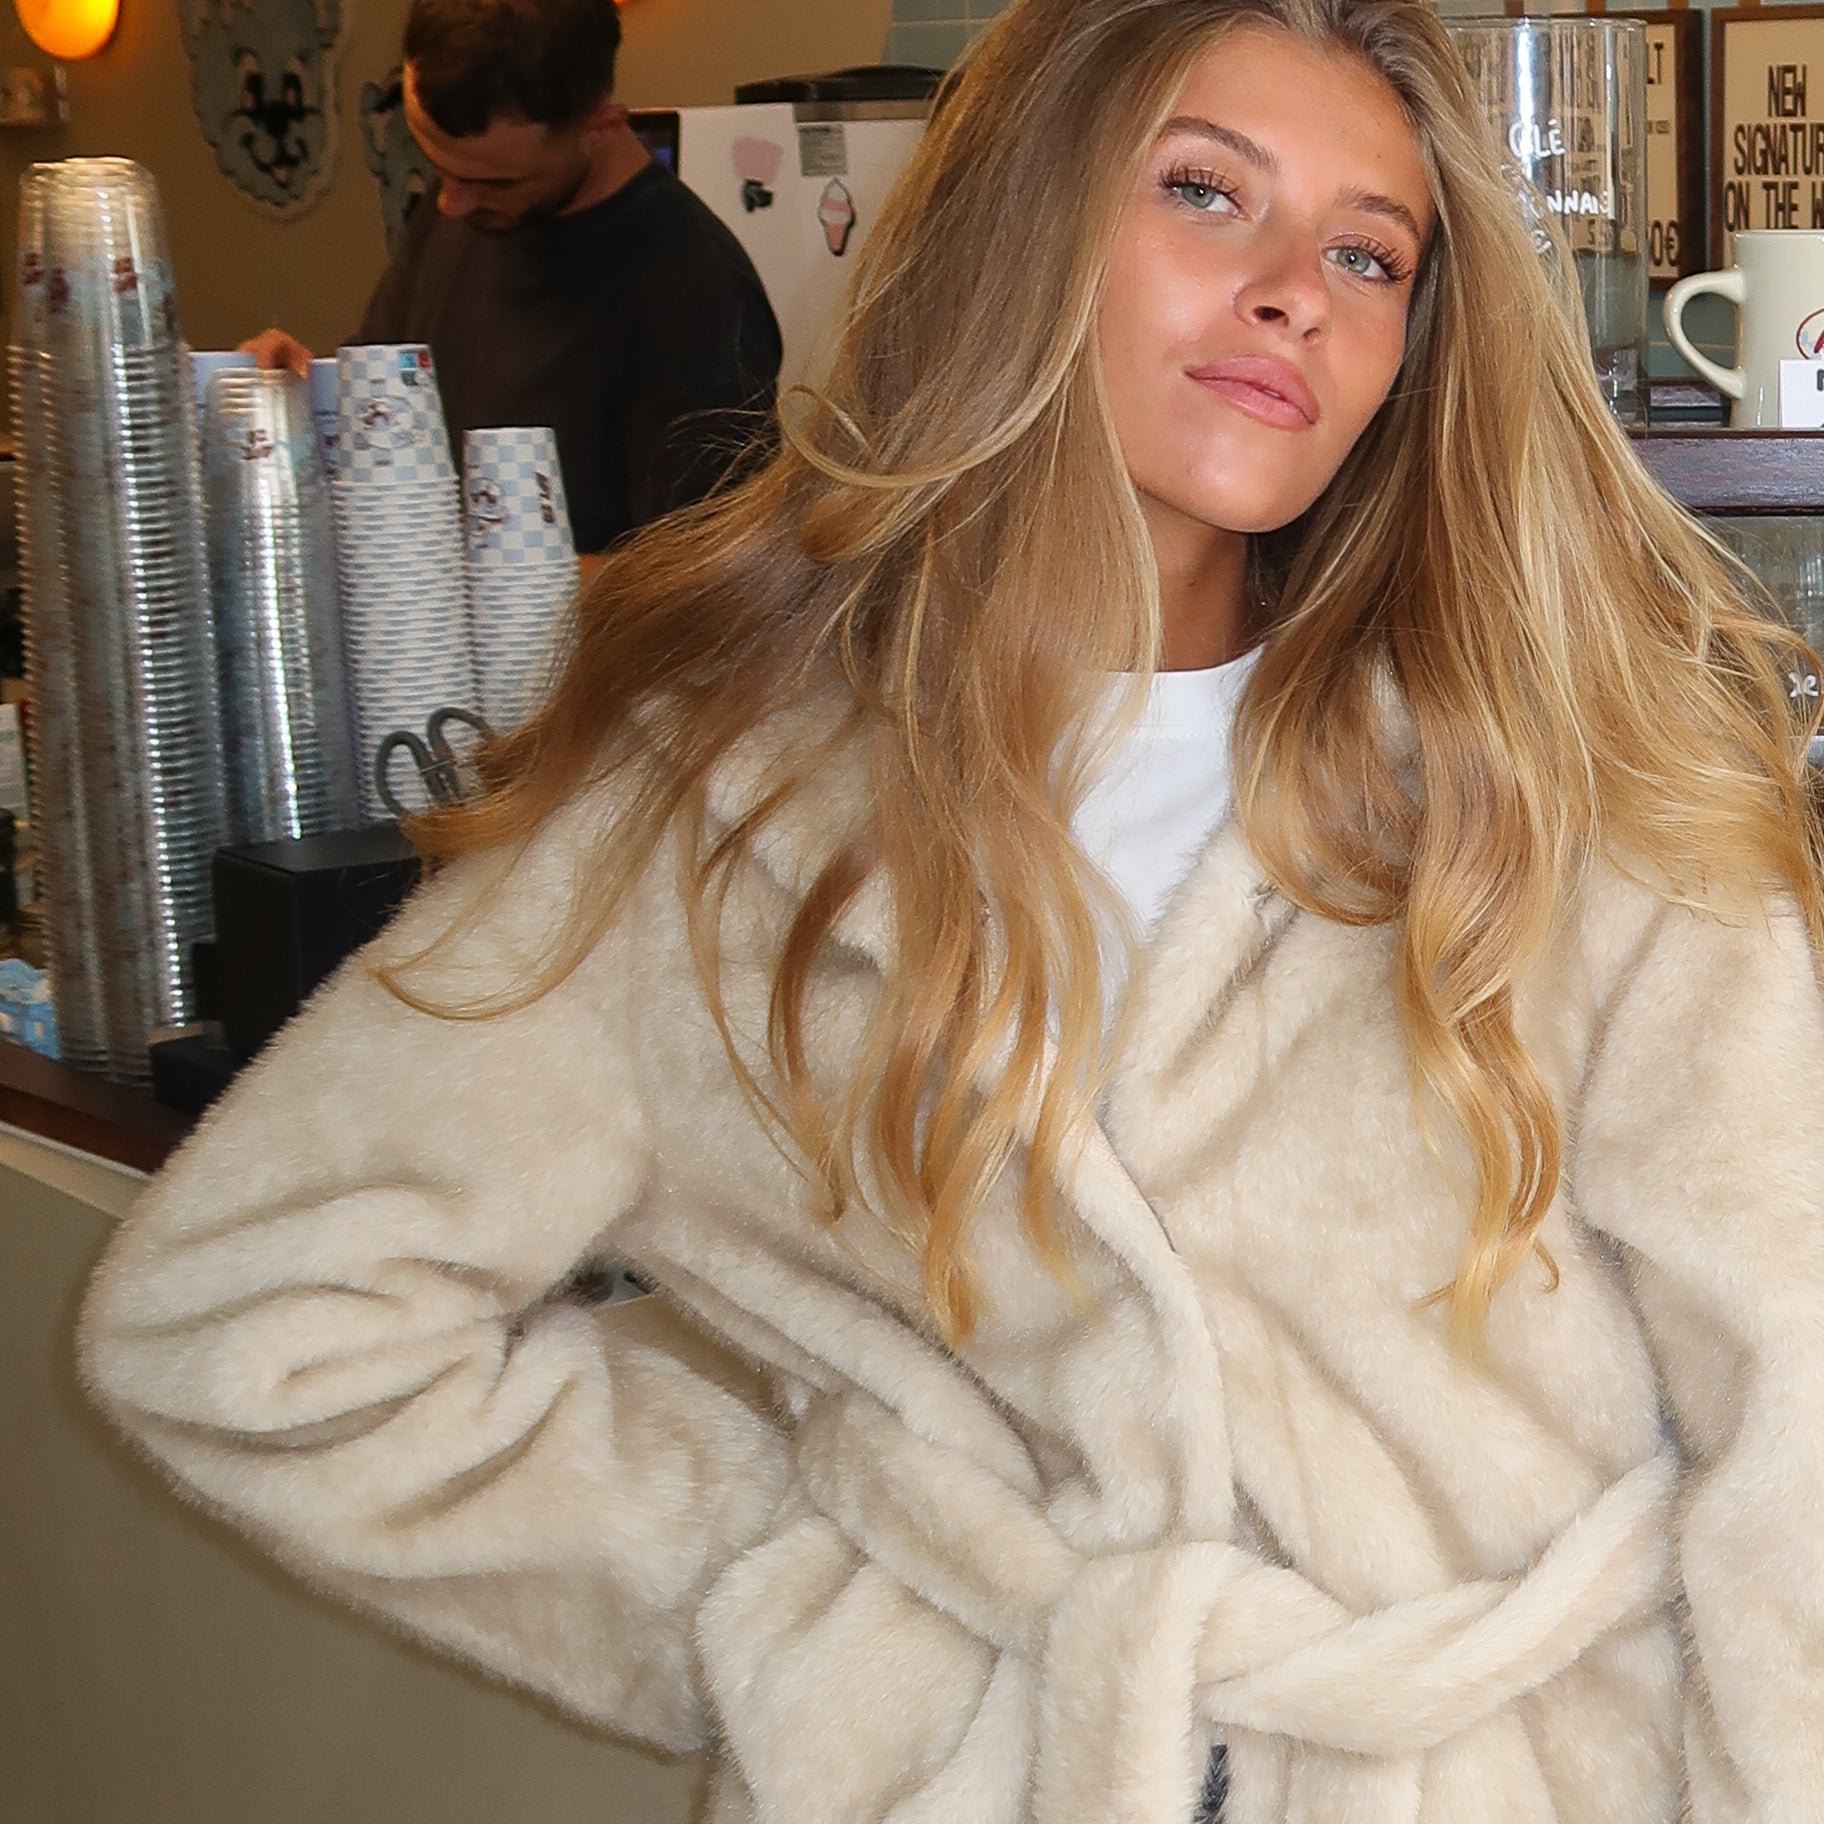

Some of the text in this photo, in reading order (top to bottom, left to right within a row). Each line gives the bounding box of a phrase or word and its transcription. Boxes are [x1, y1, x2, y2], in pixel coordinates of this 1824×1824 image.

[1768, 64, 1807, 117] NEW
[1725, 180, 1750, 232] ON
[1762, 181, 1799, 229] THE
